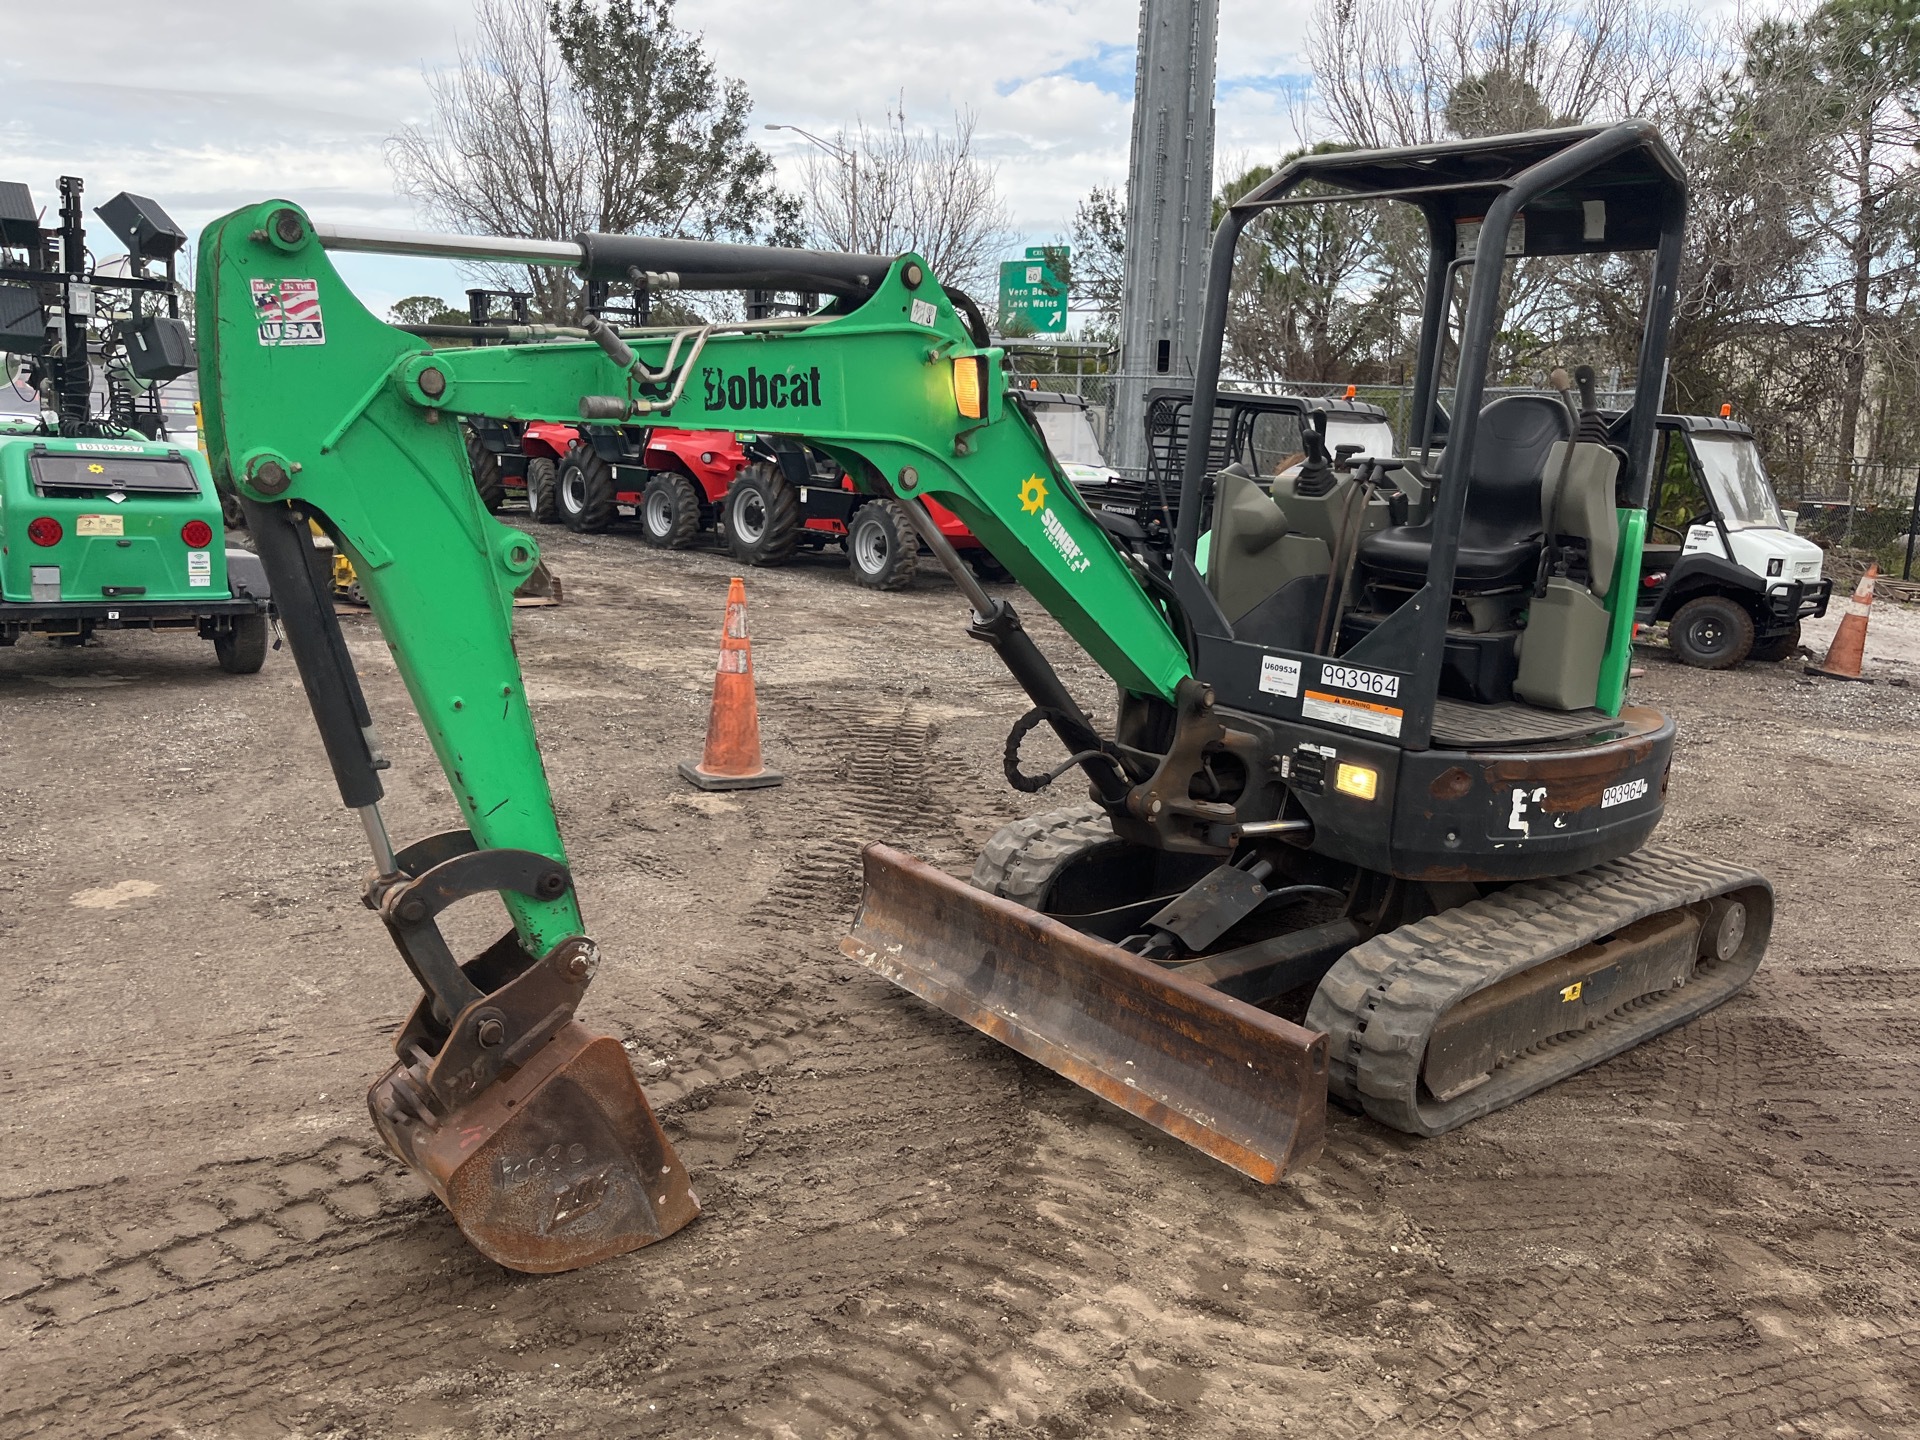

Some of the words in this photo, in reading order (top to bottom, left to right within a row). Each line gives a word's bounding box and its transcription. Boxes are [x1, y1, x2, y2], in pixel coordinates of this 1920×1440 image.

[1028, 273, 1038, 281] 60
[1008, 287, 1028, 296] Vero
[1007, 299, 1028, 308] Lake
[1032, 300, 1058, 308] Wales
[262, 323, 319, 339] USA
[702, 366, 821, 411] Bobcat
[1101, 503, 1136, 516] Kawasaki
[1264, 662, 1297, 675] U609534
[1323, 665, 1396, 696] 993964
[1342, 699, 1371, 709] WARNING
[1603, 780, 1643, 805] 993964
